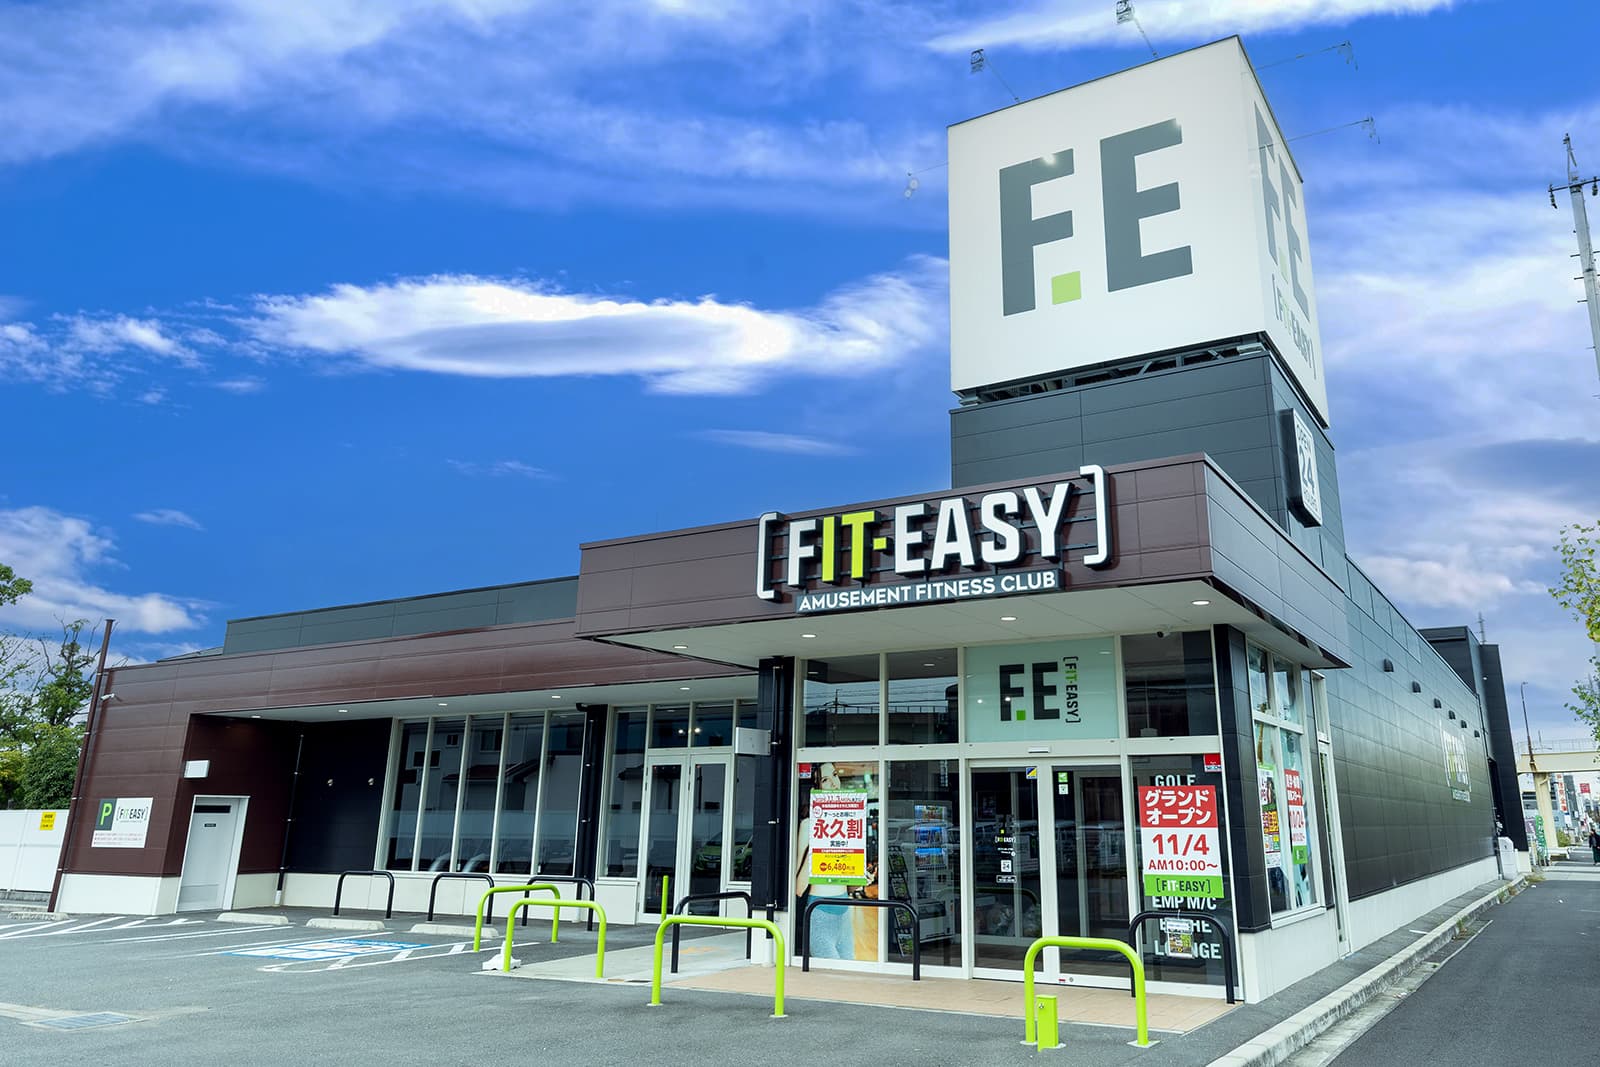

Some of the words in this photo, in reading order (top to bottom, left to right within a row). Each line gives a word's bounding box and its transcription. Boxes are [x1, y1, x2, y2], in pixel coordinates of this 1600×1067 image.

[798, 584, 911, 612] AMUSEMENT
[914, 576, 996, 601] FITNESS
[1000, 570, 1056, 593] CLUB
[1145, 789, 1210, 808] グランド
[100, 802, 113, 826] P
[1145, 808, 1212, 826] オープン
[813, 818, 863, 840] 永久割
[1152, 833, 1210, 857] 11/4
[1187, 897, 1217, 910] M/C
